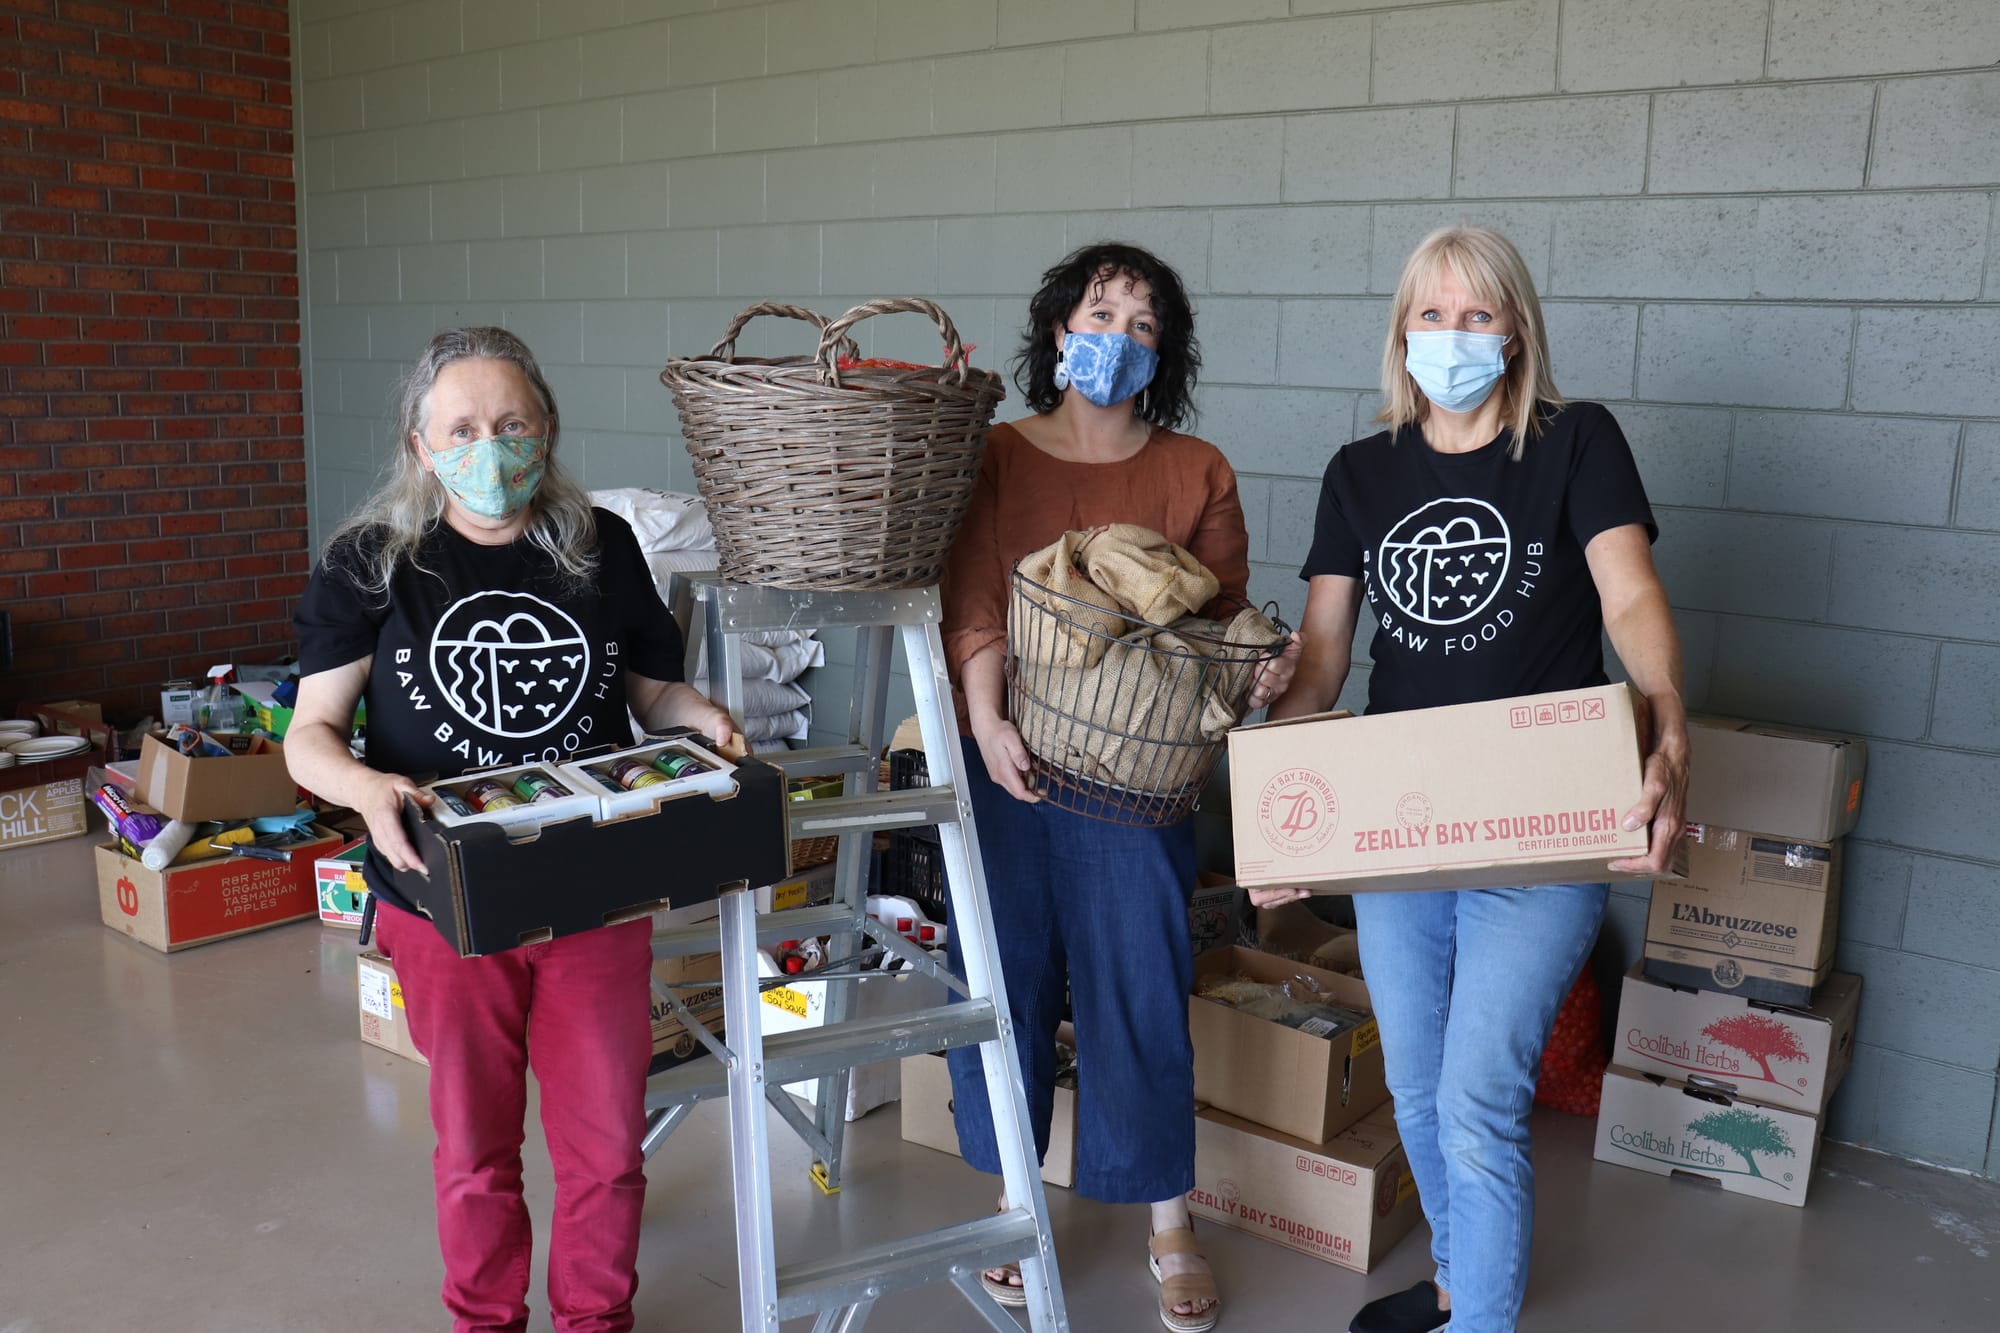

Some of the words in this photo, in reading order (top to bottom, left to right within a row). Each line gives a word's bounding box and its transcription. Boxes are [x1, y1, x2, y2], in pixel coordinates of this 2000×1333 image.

[1381, 611, 1429, 653] BAW
[1444, 609, 1514, 656] FOOD
[1516, 541, 1544, 598] HUB
[395, 648, 432, 710] BAW
[433, 721, 504, 767] BAW
[522, 714, 594, 766] FOOD
[594, 640, 619, 700] HUB
[46, 784, 81, 798] APPLES
[1261, 783, 1278, 820] ZEALLY
[1277, 772, 1296, 785] BAY
[1299, 772, 1336, 813] SOURDOUGH
[0, 790, 41, 821] CK
[1, 817, 47, 840] HILL
[1353, 826, 1429, 853] ZEALLY
[1436, 821, 1478, 846] BAY
[1483, 808, 1617, 841] SOURDOUGH
[1518, 837, 1569, 852] CERTIFIED
[1572, 833, 1618, 847] ORGANIC
[252, 865, 291, 881] SMITH
[222, 877, 280, 897] ORGANIC
[223, 883, 297, 907] TASMANIAN
[223, 898, 277, 918] APPLES
[767, 994, 782, 1008] Soy
[784, 1001, 807, 1017] Sauce
[1626, 1028, 1690, 1061] Coolibah
[1696, 1044, 1740, 1072] Herbs
[1610, 1125, 1675, 1157] Coolibah
[1680, 1140, 1725, 1168] Herbs
[1188, 1188, 1238, 1215] ZEALLY
[1240, 1204, 1267, 1225] BAY
[1269, 1214, 1353, 1254] SOURDOUGH
[1288, 1235, 1321, 1252] CERTIFIED
[1321, 1246, 1352, 1262] ORGANIC
